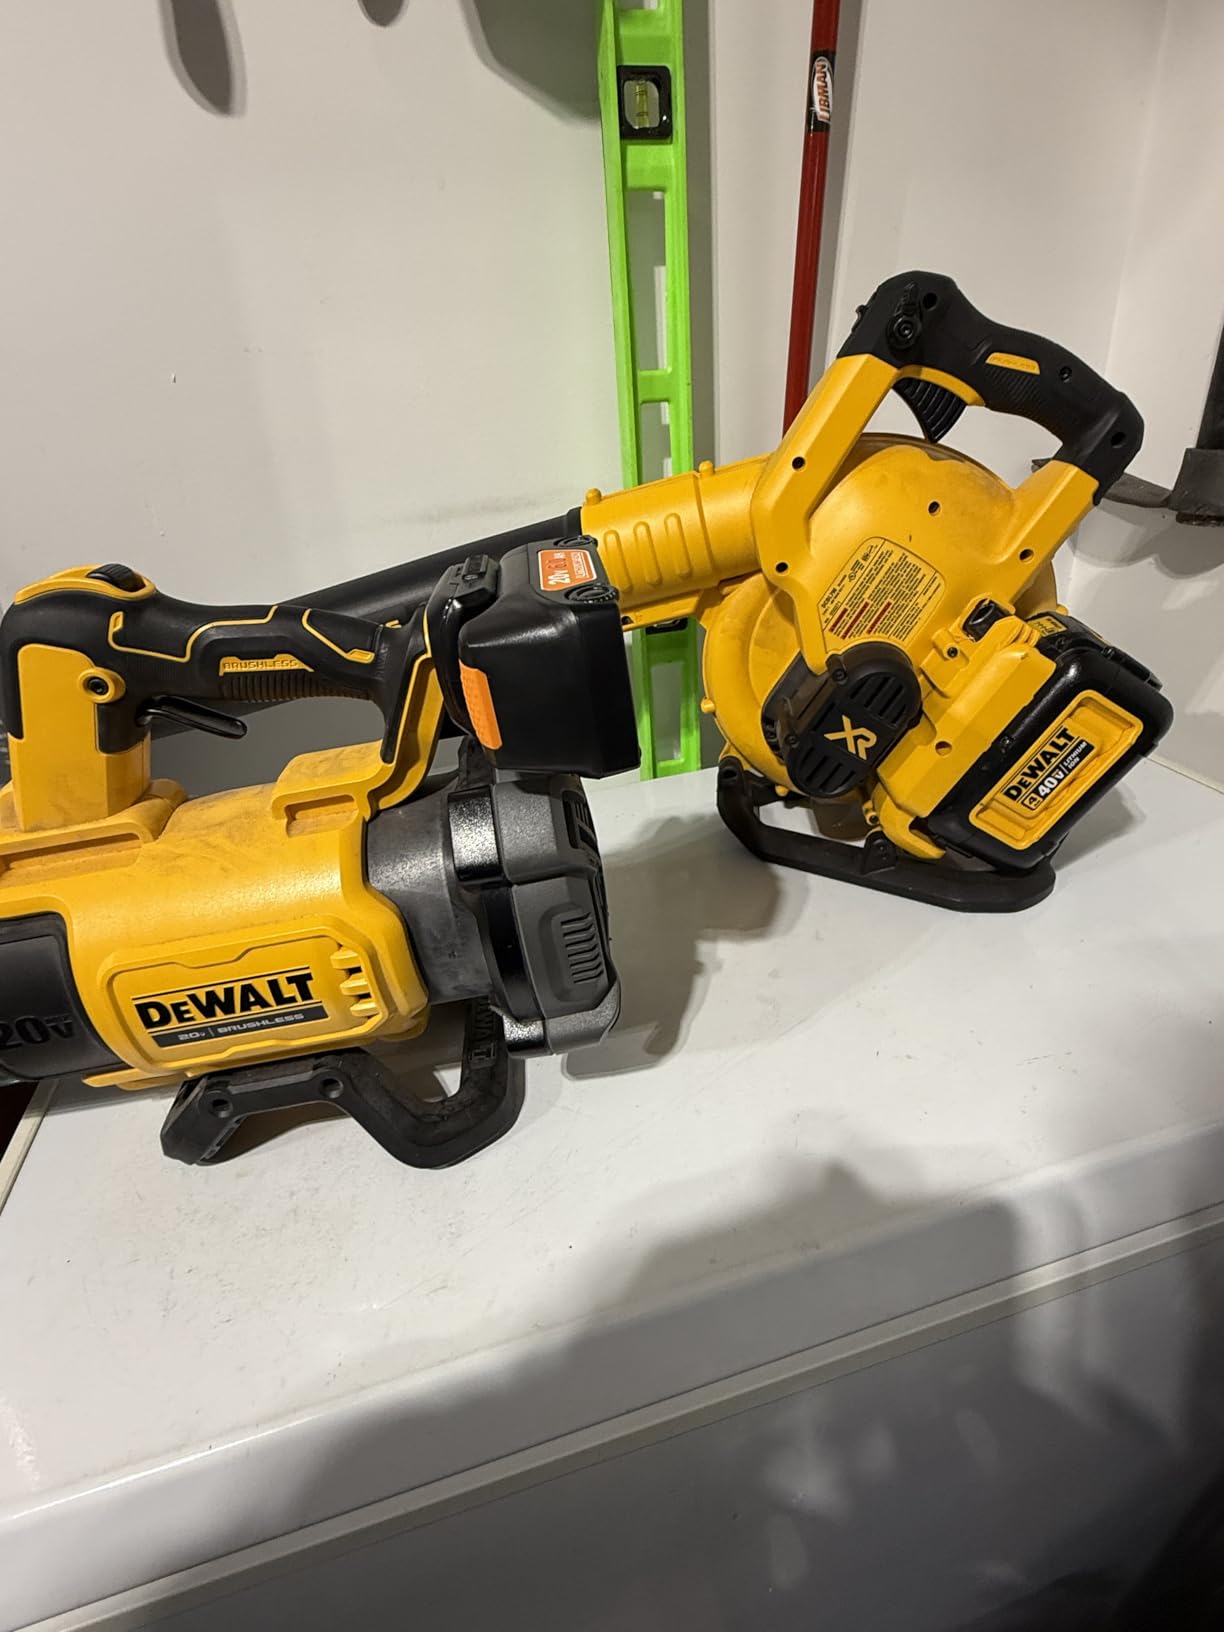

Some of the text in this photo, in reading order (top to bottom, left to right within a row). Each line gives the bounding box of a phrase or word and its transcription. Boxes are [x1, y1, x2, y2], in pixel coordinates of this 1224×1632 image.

[815, 61, 831, 122] LIBMAN
[223, 659, 298, 670] BRUSHLESS
[824, 714, 877, 760] XR
[1063, 741, 1088, 767] LITHIUM
[1003, 727, 1075, 801] DEWALT
[1067, 756, 1081, 770] ION
[134, 972, 314, 1030] DEWALT
[217, 1012, 305, 1034] BRUSHLESS
